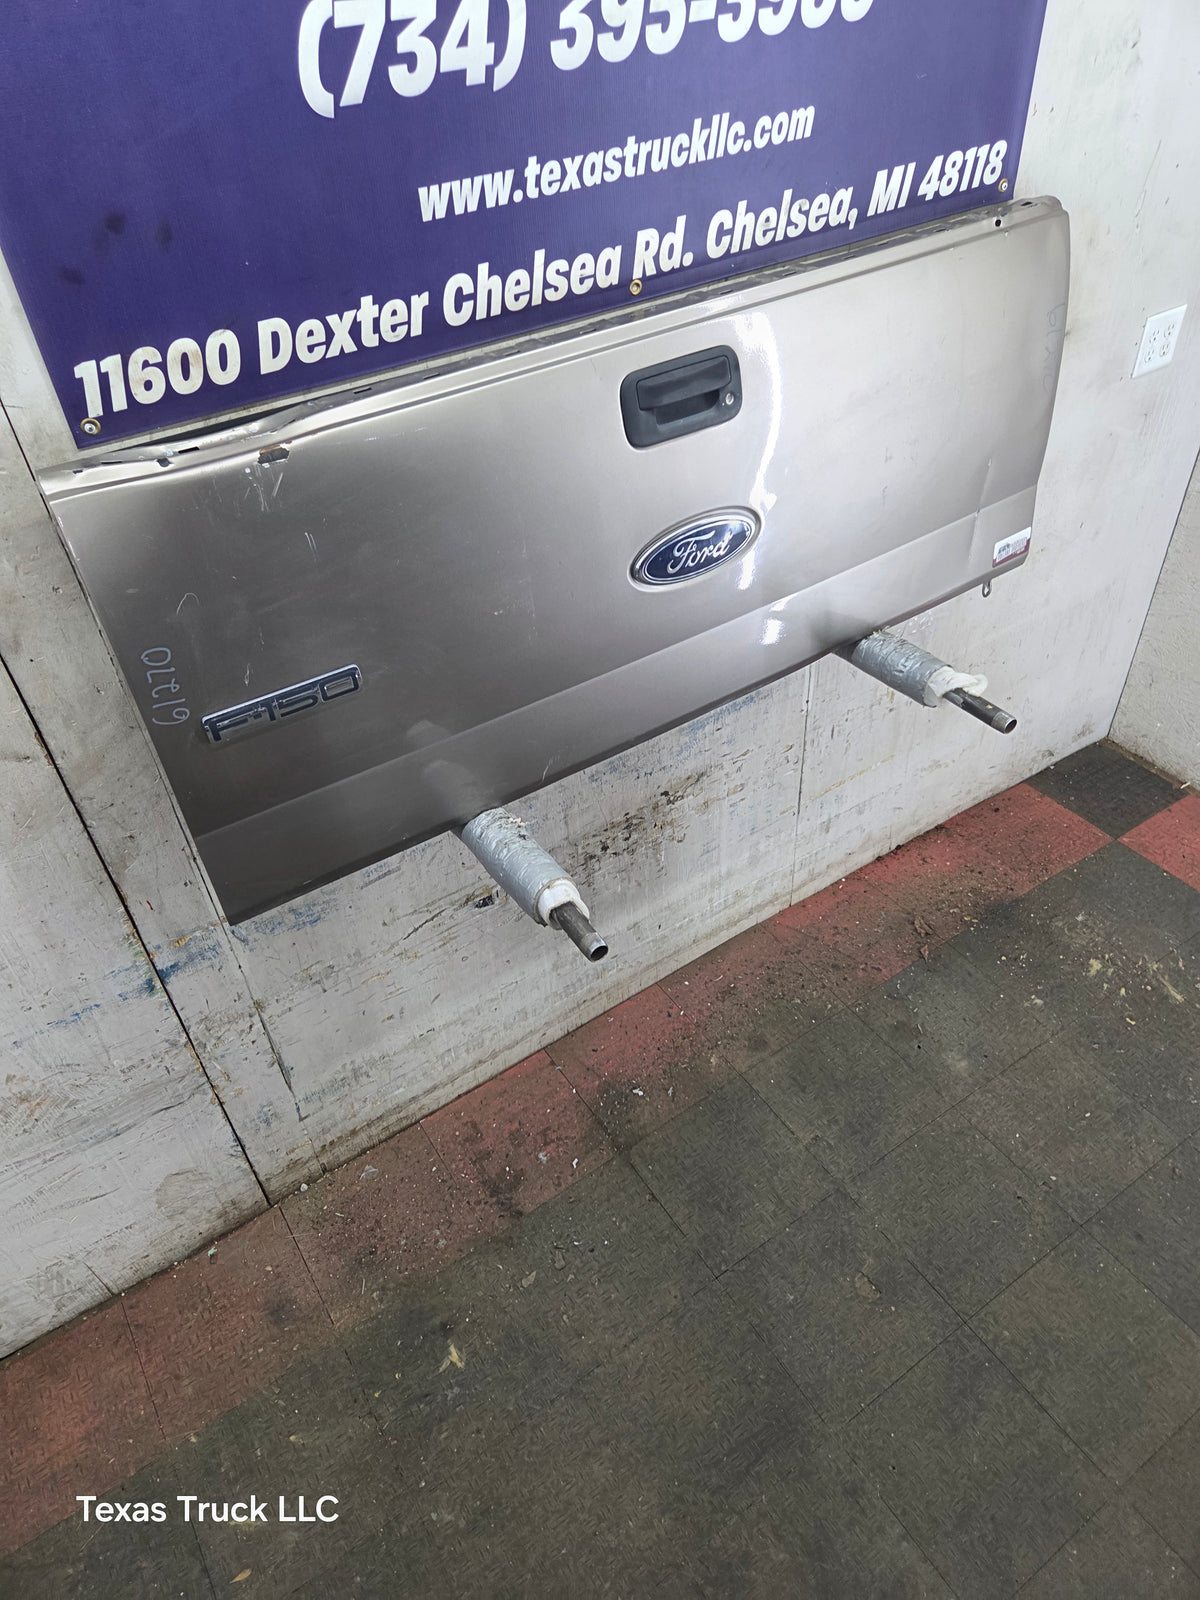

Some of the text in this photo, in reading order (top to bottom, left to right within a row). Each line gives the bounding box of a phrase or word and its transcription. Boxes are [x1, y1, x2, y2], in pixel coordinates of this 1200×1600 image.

[298, 0, 526, 118] (734)
[418, 105, 815, 222] www.texastruckllc.com
[74, 140, 1007, 418] 11600 Dexter Chelsea Rd. Chelsea, MI 48118
[667, 530, 733, 574] Ford
[204, 666, 361, 742] F-150
